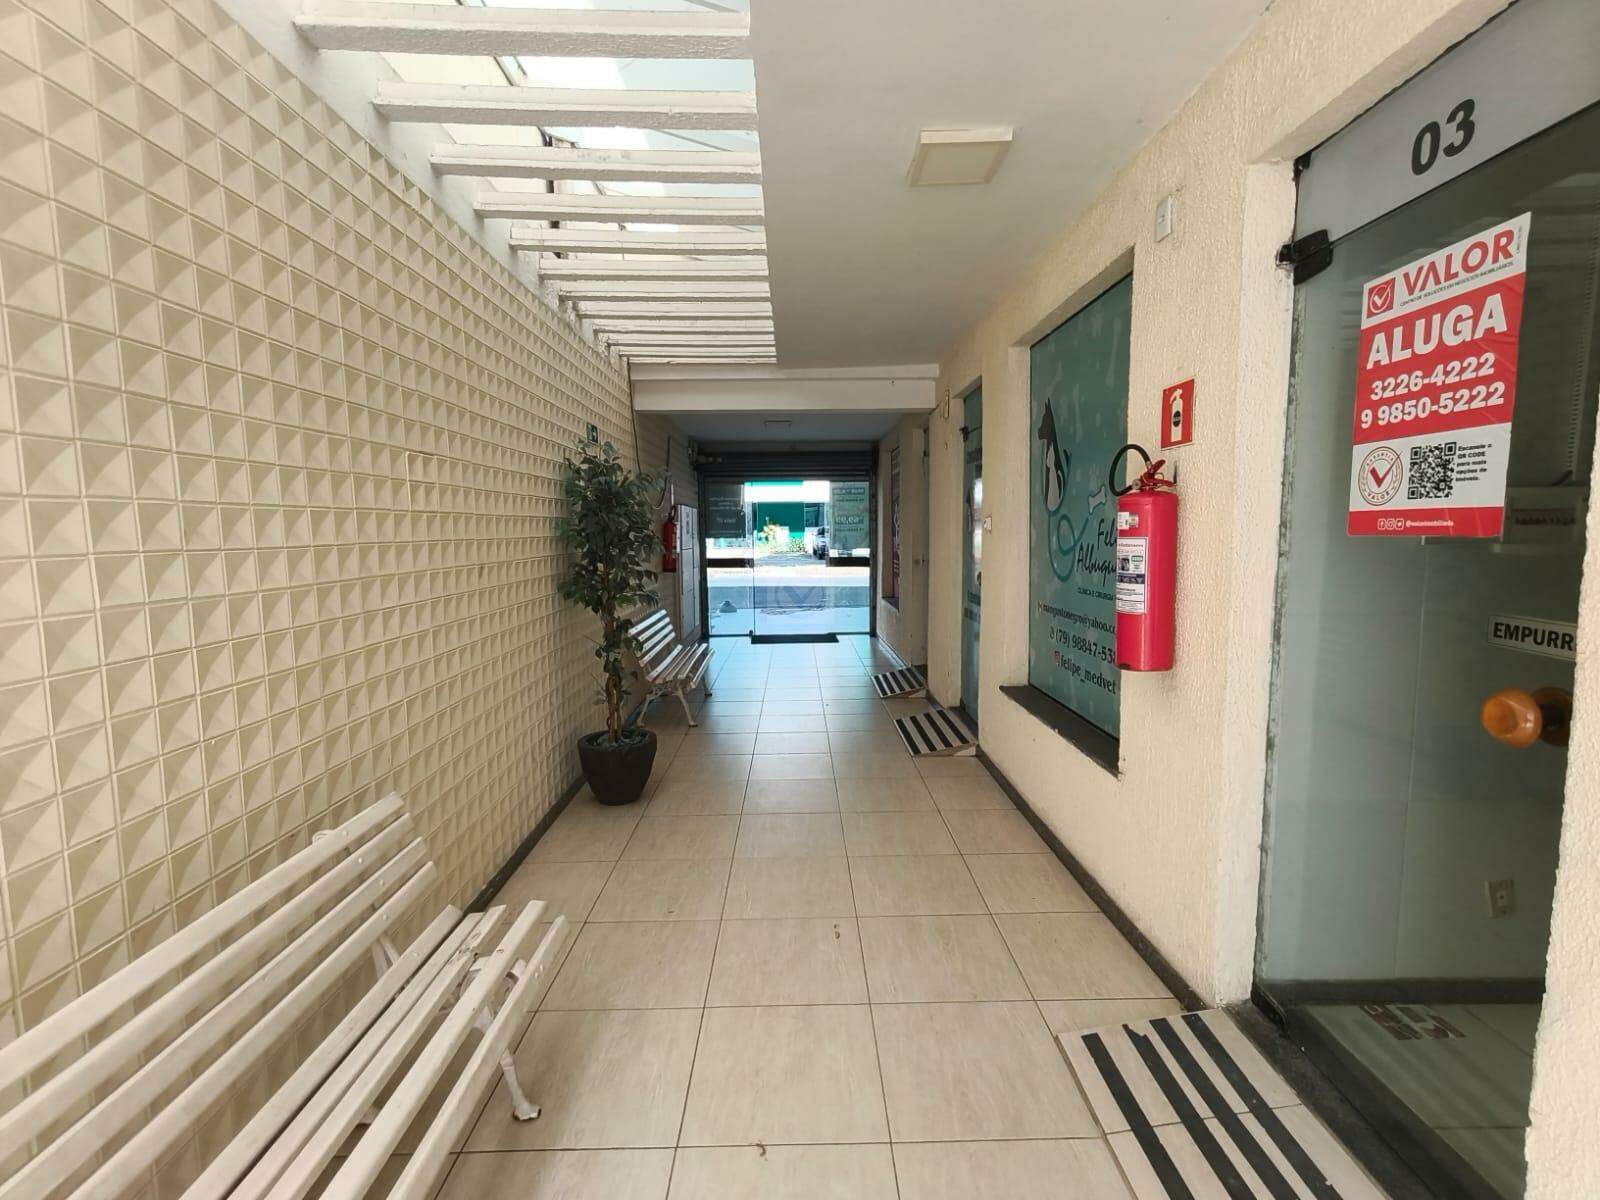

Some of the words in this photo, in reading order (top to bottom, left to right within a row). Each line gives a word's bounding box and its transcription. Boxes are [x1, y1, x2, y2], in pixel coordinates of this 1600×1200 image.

[1411, 98, 1475, 176] 03
[1402, 229, 1515, 297] VALOR
[1366, 293, 1508, 370] ALUGA
[1370, 352, 1496, 401] 3226-4222
[1360, 409, 1373, 429] 9
[1377, 381, 1506, 426] 9850-5222
[1097, 517, 1117, 551] Fel
[1076, 542, 1117, 587] Albuqu
[1055, 627, 1070, 648] (79)
[1071, 634, 1116, 664] 98847-53
[1493, 622, 1574, 651] EMPURR
